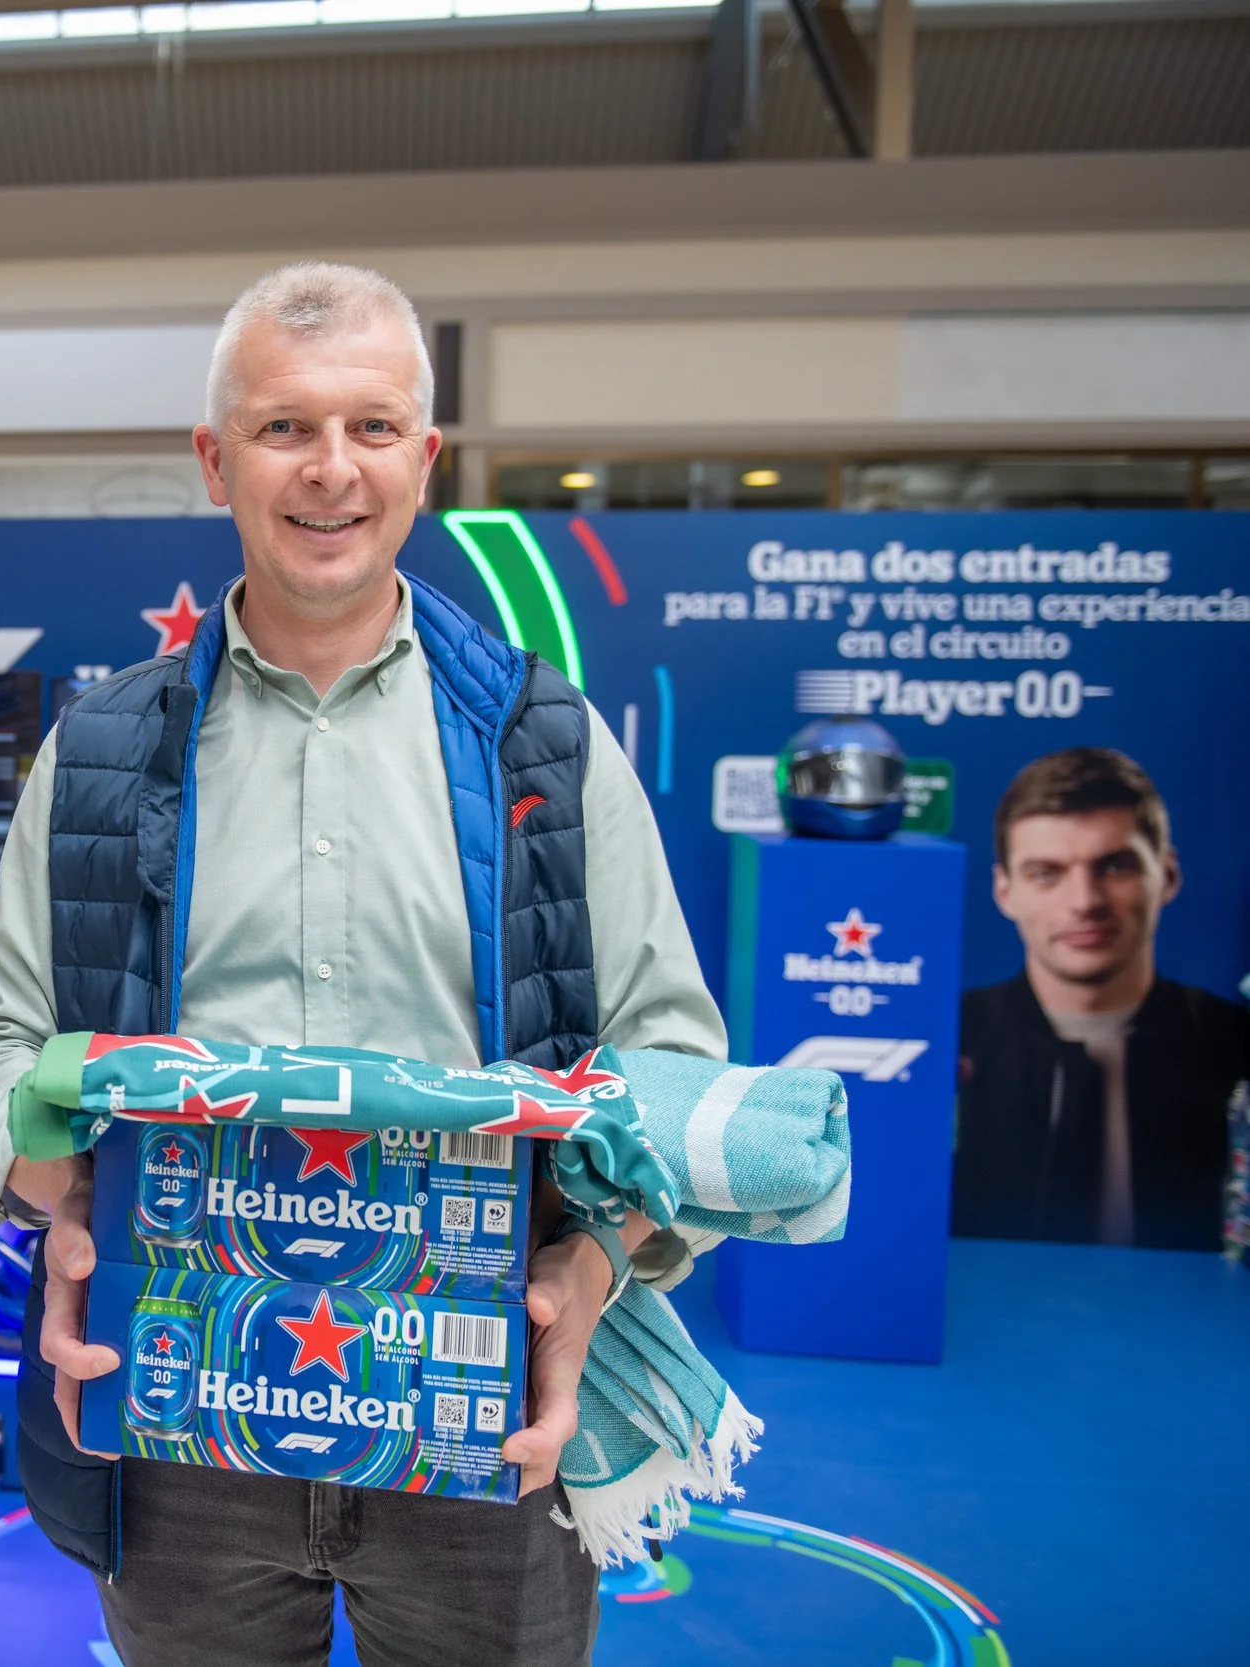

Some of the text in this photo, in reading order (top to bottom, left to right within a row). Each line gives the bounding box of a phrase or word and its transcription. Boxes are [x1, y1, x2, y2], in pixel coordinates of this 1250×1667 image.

[748, 540, 1170, 585] Gana dos entradas
[662, 591, 749, 627] para
[753, 584, 789, 621] la
[847, 591, 876, 628] y
[879, 587, 955, 621] vive
[961, 593, 1034, 622] una
[1038, 587, 1250, 629] experiencia
[837, 623, 1071, 660] en el circuito
[848, 670, 1014, 726] Player
[783, 952, 924, 986] Heineken
[145, 1162, 199, 1178] Heineken
[396, 1150, 428, 1160] ALCOHOL
[374, 1306, 425, 1346] 0.0
[135, 1352, 191, 1370] Heineken
[374, 1345, 421, 1357] SIN ALCOHOL
[374, 1353, 389, 1362] SEM
